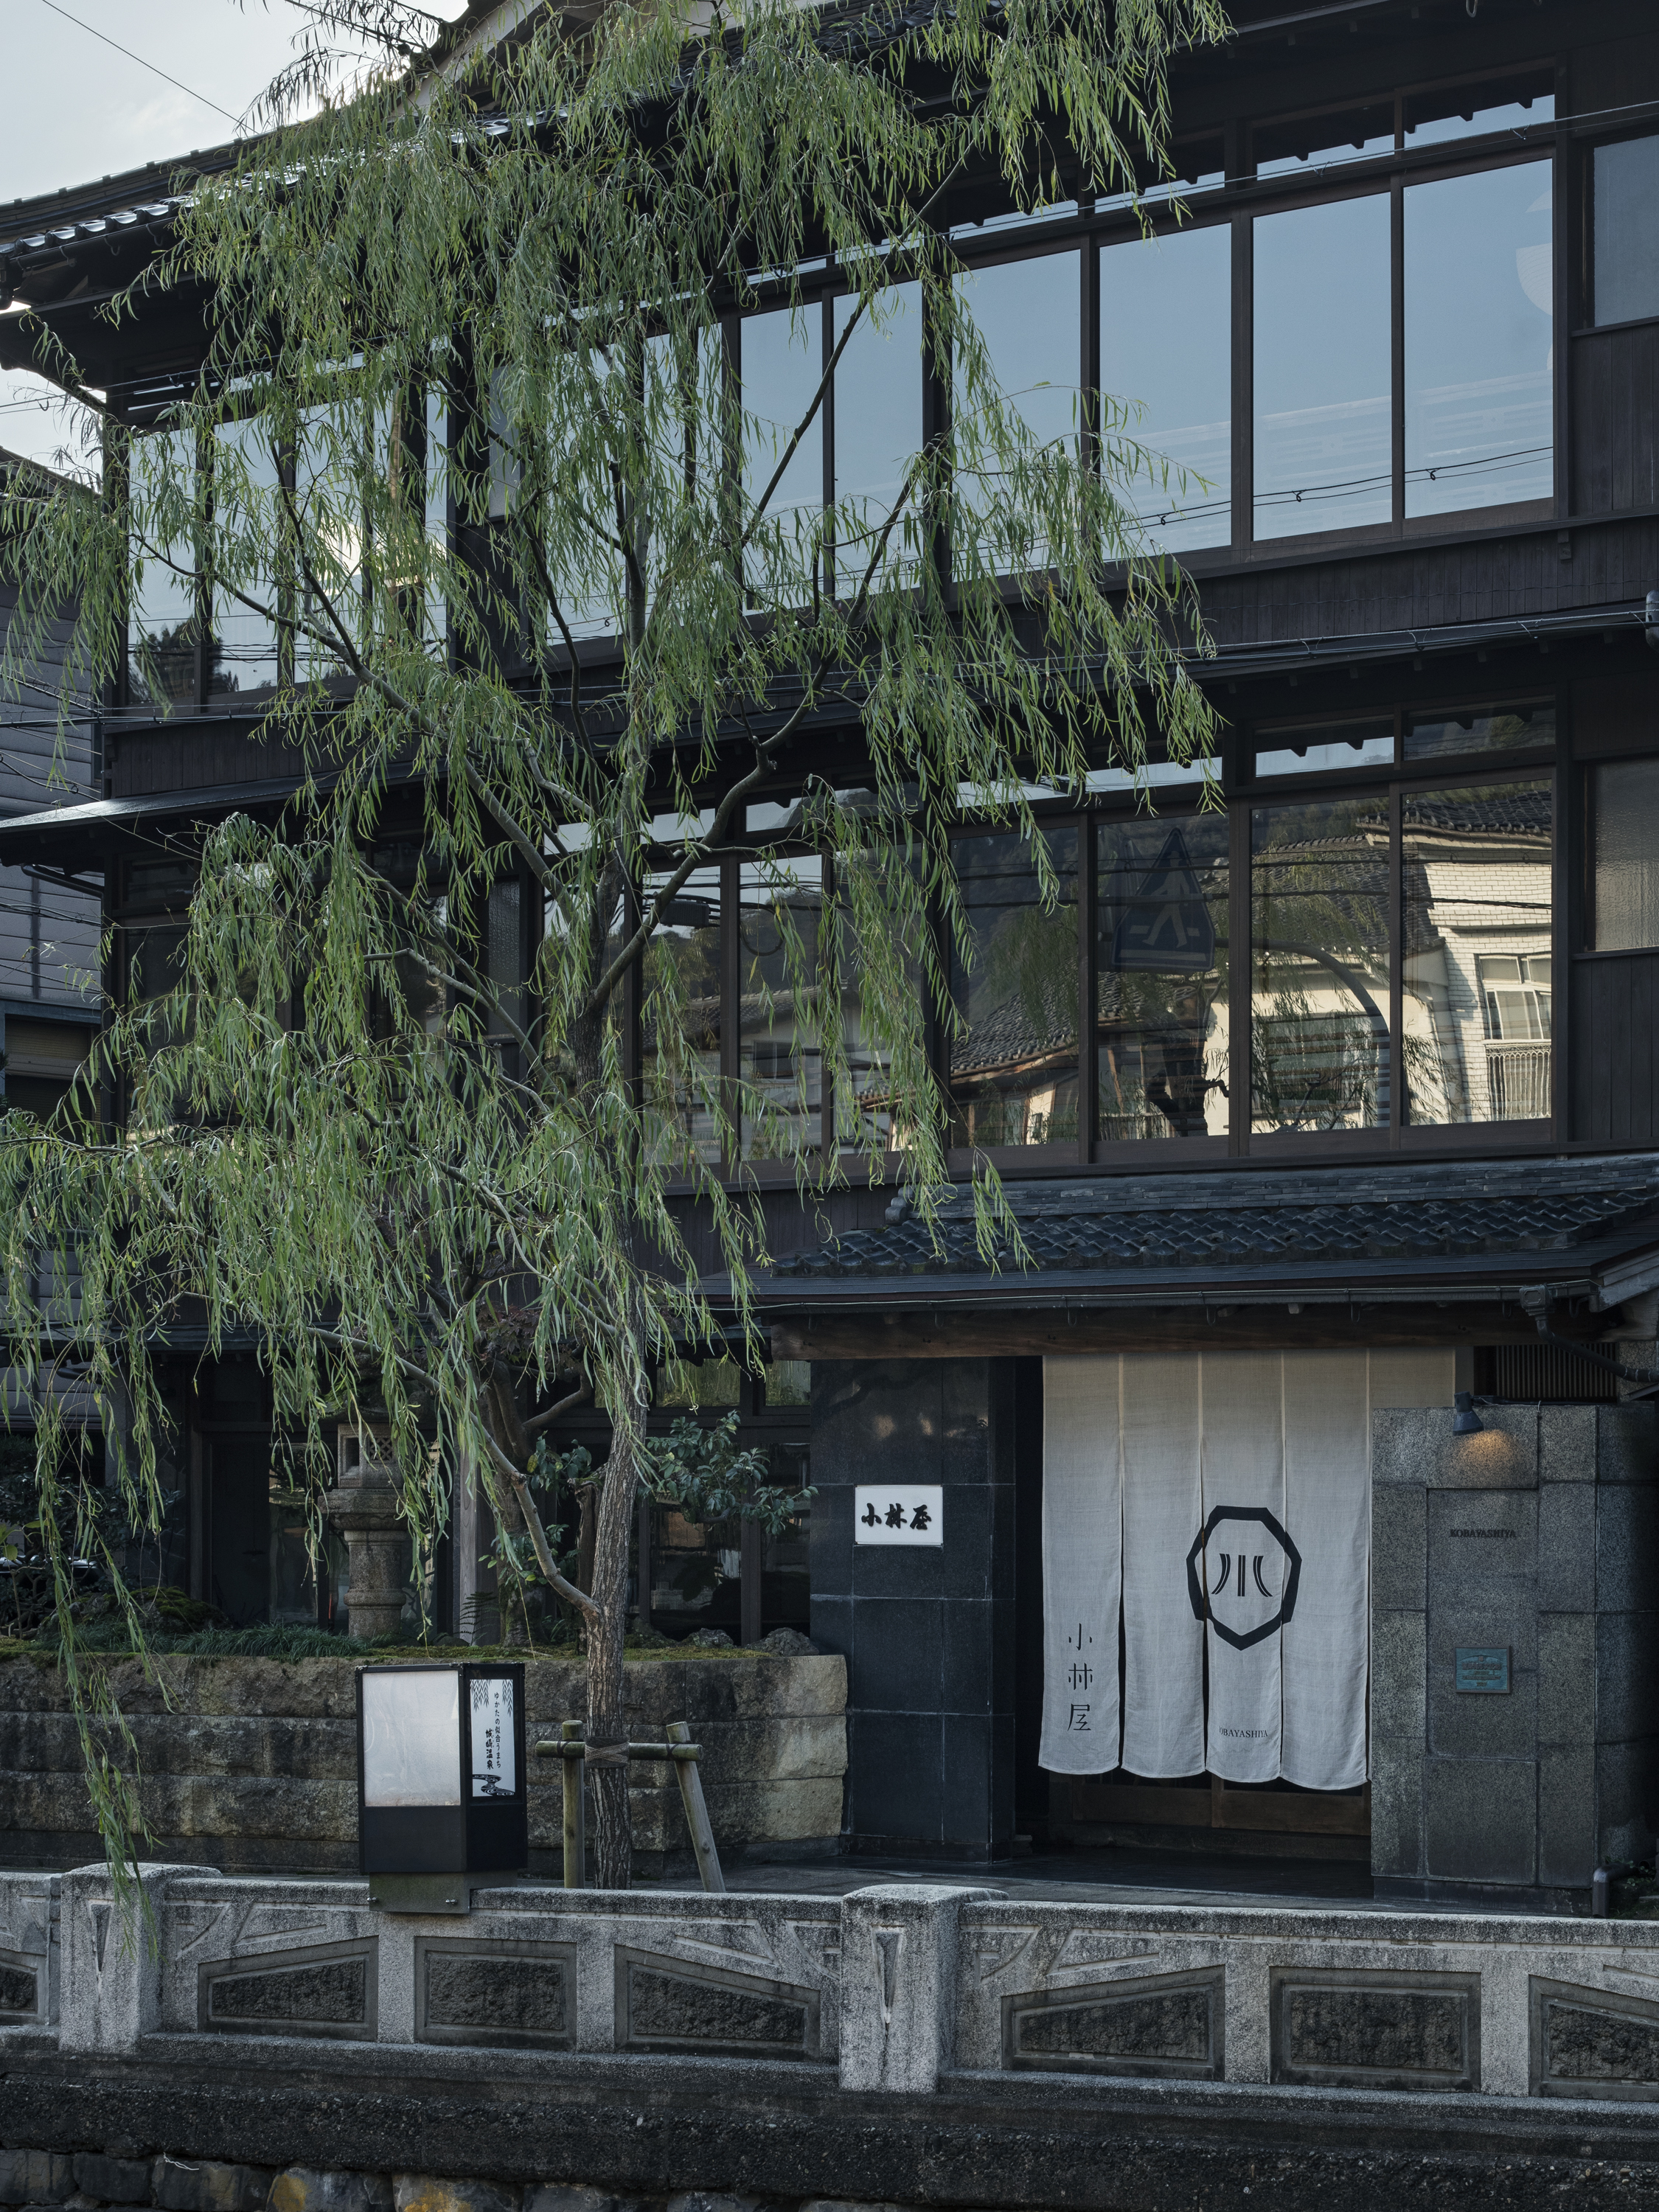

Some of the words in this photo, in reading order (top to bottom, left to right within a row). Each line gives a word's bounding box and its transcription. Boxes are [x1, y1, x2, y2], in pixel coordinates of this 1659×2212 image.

[861, 1503, 931, 1530] 小林屋
[1450, 1528, 1517, 1538] KOBAYASHIYA
[1068, 1623, 1093, 1731] 小林屋
[1219, 1726, 1268, 1739] OBAYASHIYA
[485, 1728, 494, 1770] 城崎温泉
